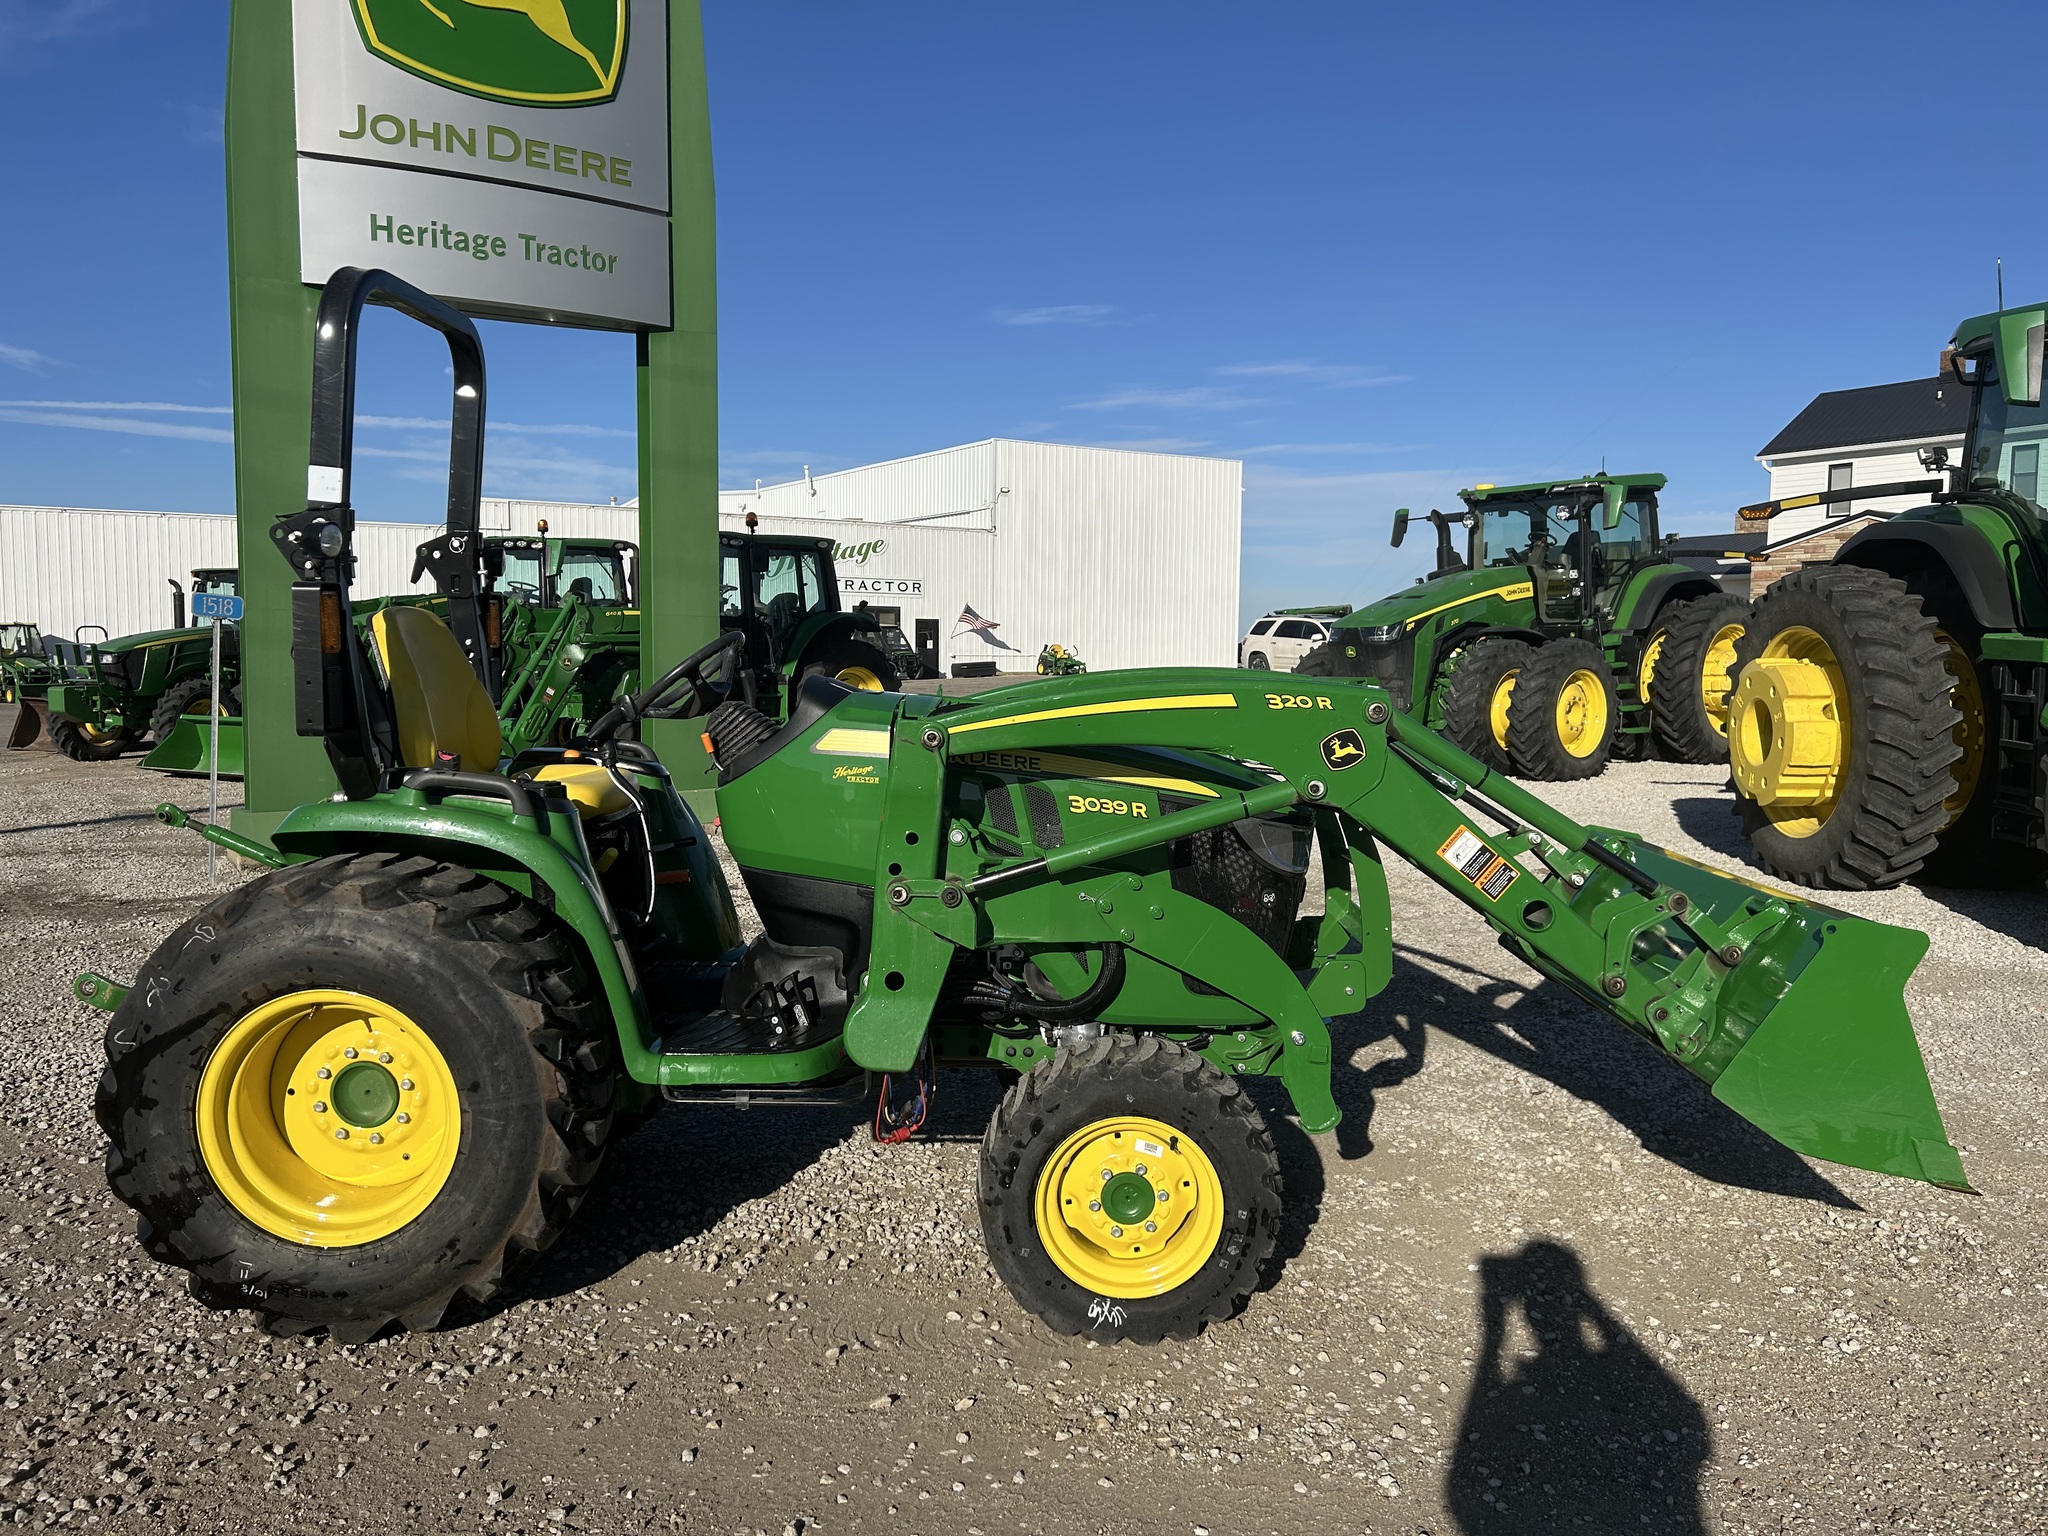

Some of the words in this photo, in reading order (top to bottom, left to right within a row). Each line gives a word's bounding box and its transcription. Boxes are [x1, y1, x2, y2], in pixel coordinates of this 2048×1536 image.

[338, 104, 477, 158] JOHN
[487, 124, 633, 188] DEERE
[369, 213, 508, 262] Heritage
[518, 233, 618, 275] Tractor
[202, 596, 234, 616] 1518
[1264, 693, 1313, 710] 320
[1315, 696, 1335, 710] R
[969, 752, 1041, 771] DEERE
[832, 765, 874, 779] Heritage
[846, 776, 880, 784] TRACTOR
[1067, 795, 1129, 815] 3039
[1131, 801, 1149, 819] R
